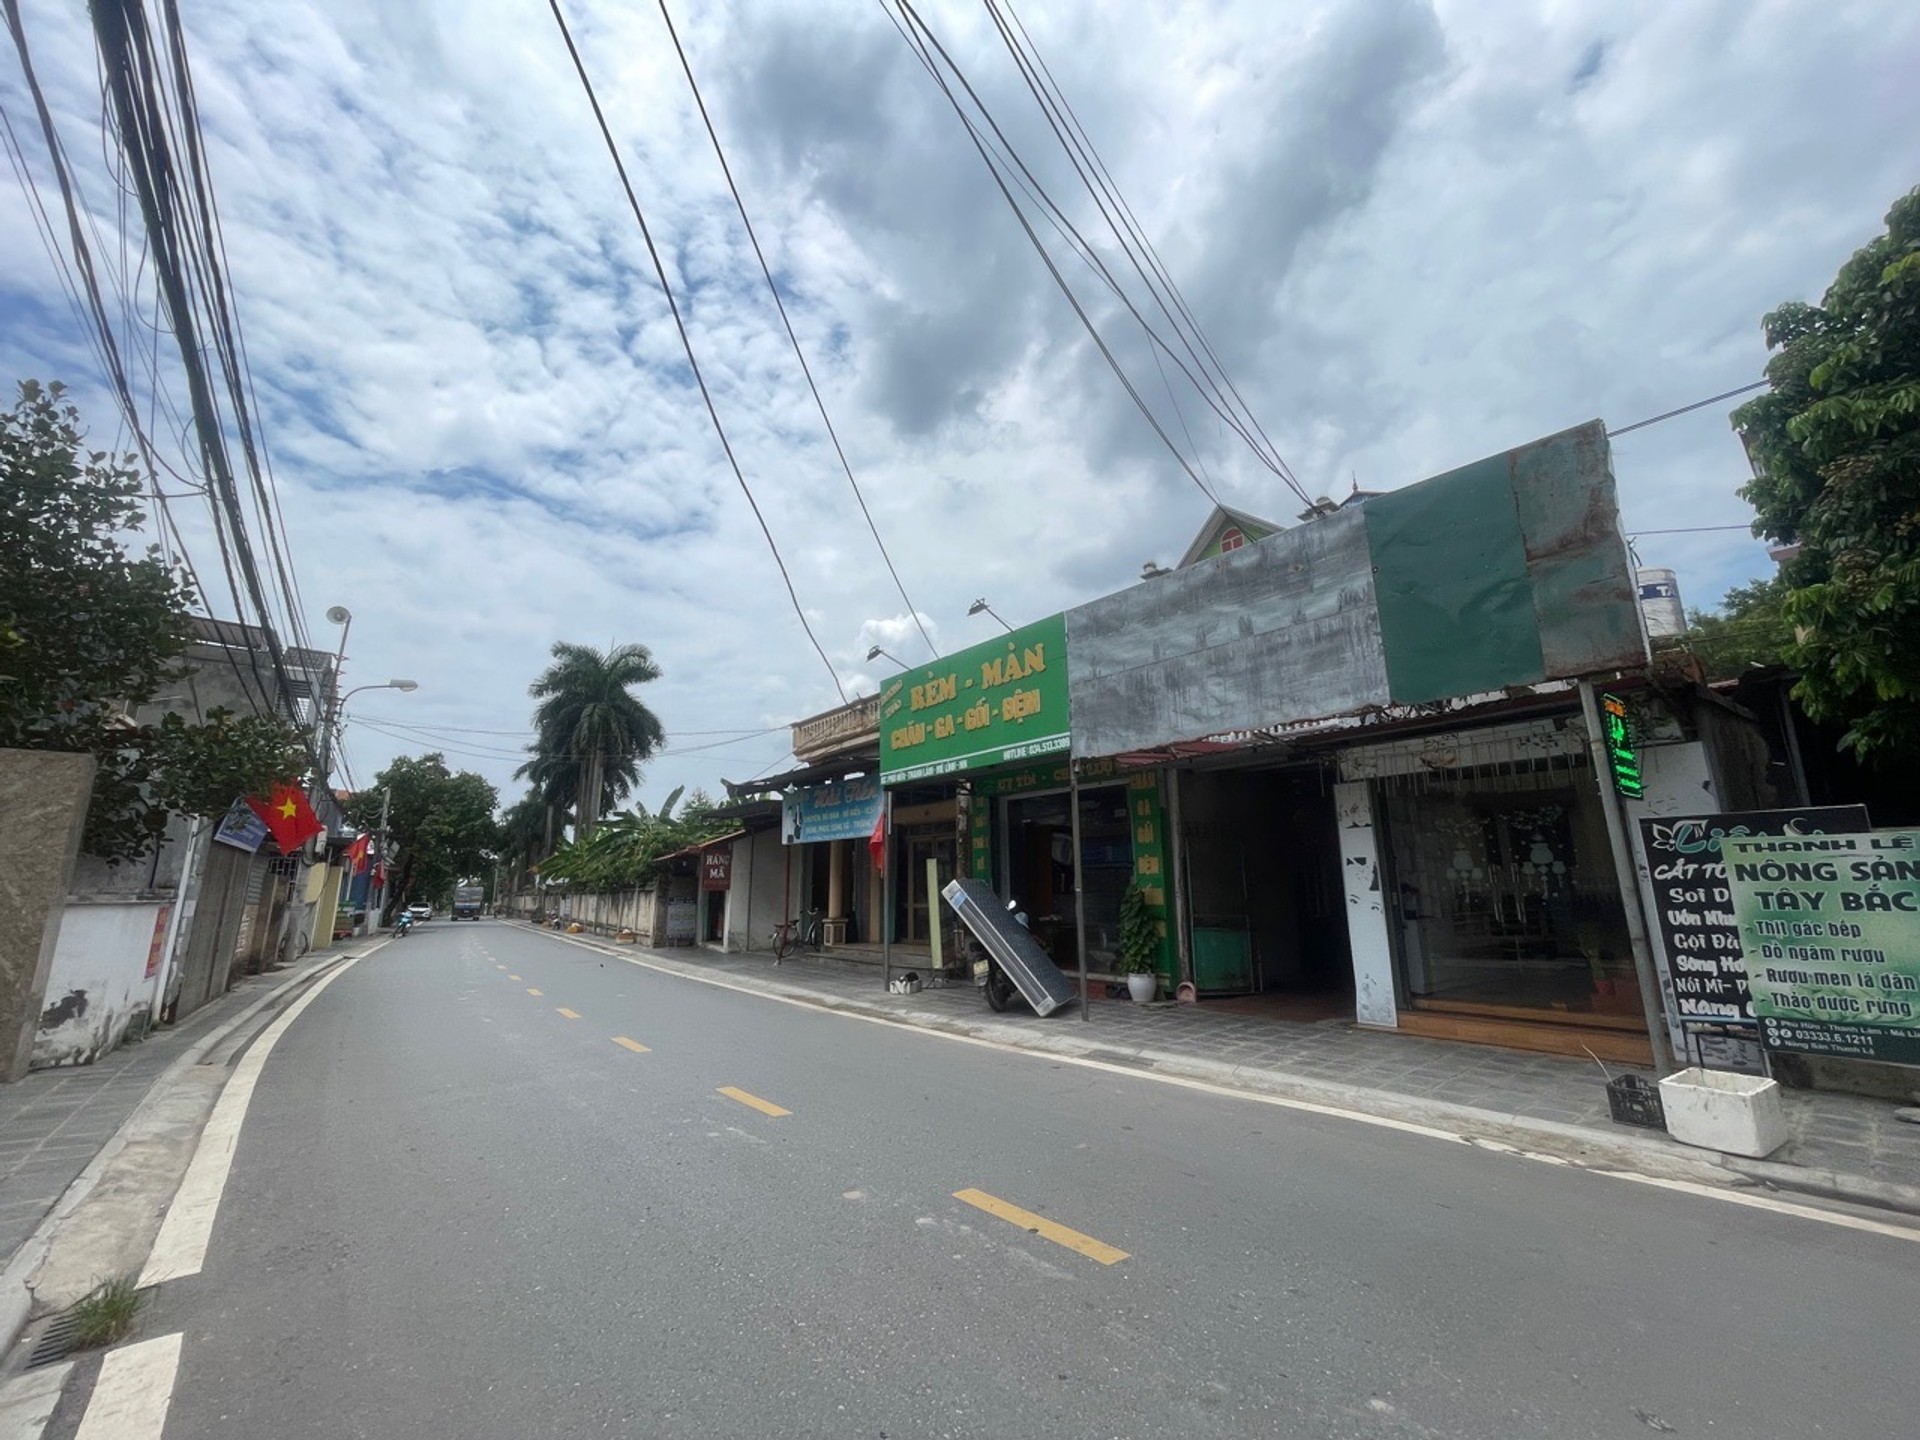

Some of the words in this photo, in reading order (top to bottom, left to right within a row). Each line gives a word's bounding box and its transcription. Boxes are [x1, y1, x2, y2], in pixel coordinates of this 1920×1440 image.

[935, 714, 955, 738] GA
[1732, 839, 1856, 853] THANH
[1870, 836, 1914, 851] LỆ
[1734, 859, 1838, 882] NÔNG
[1850, 855, 1920, 881] SẢN
[1754, 887, 1825, 911] TÂY
[1840, 884, 1919, 911] BẮC
[1792, 919, 1824, 937] gác
[1828, 920, 1862, 938] bếp
[1788, 945, 1835, 962] ngâm
[1813, 971, 1852, 987] men
[1857, 971, 1875, 988] lá
[1770, 992, 1811, 1010] Thảo
